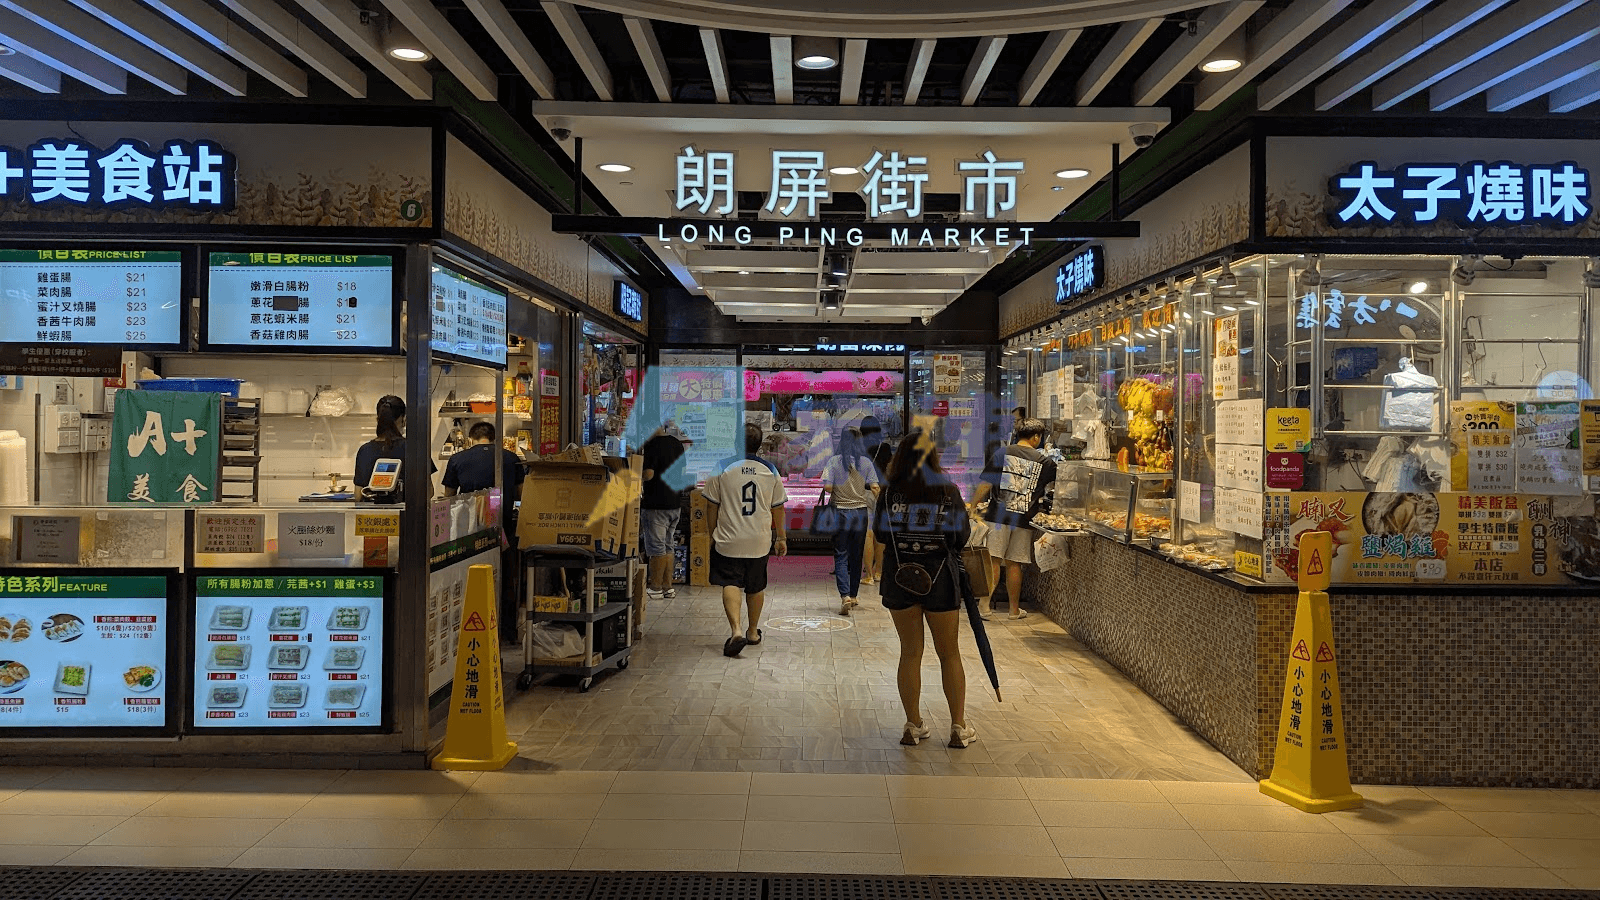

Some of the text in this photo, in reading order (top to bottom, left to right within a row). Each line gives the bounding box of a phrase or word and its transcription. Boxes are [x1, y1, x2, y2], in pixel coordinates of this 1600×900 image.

[675, 146, 1024, 218] 朗屏街市
[1338, 164, 1589, 222] 太子燒味
[407, 204, 417, 217] 6
[658, 223, 1035, 247] LONG PING MARKET
[300, 255, 332, 263] PRICE
[335, 255, 358, 263] LIST
[38, 272, 146, 283] 雞蛋腸 $21
[1056, 250, 1095, 302] 太子燒味
[38, 286, 146, 298] 菜肉腸 $21
[250, 280, 357, 292] 嫩滑白腸粉 $18
[38, 302, 147, 312] 蜜汁叉燒腸 $23
[250, 296, 358, 308] 蔥花腸 $1
[37, 316, 146, 327] 香茜牛肉腸 $23
[336, 314, 356, 324] $21
[36, 331, 146, 342] 鮮蝦腸 $25
[250, 330, 358, 340] 香菇雞肉腸 $23
[1278, 416, 1300, 426] keeta
[128, 473, 208, 503] 美食
[741, 480, 757, 516] 9
[1458, 496, 1518, 510] 精美飯盒
[299, 538, 323, 548] $18/份
[1474, 558, 1503, 571] 本店
[60, 584, 108, 592] FEATURE
[334, 579, 375, 589] 雞蛋+$3
[465, 637, 480, 699] 小心地滑
[1289, 666, 1304, 731] 小心地滑
[1320, 669, 1333, 735] 小心地滑
[1287, 731, 1302, 740] CAUTION
[1292, 739, 1303, 748] FLOOR
